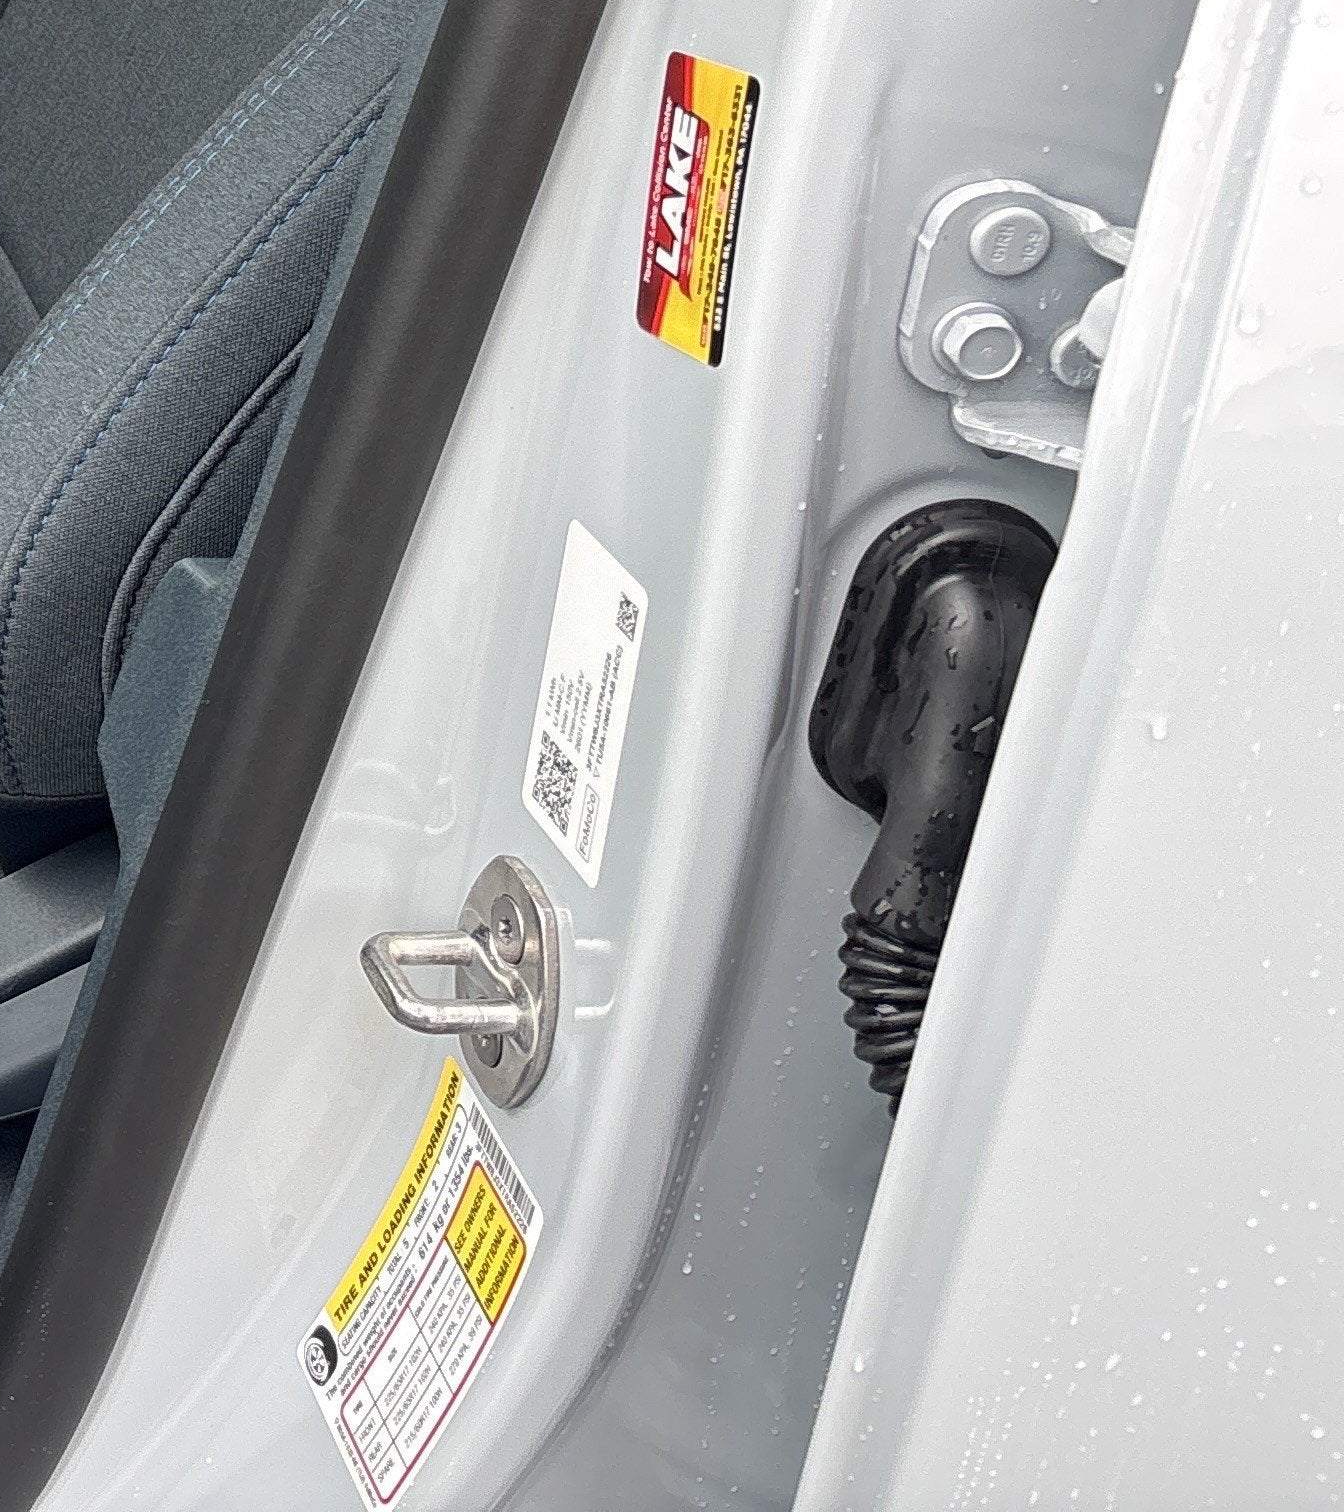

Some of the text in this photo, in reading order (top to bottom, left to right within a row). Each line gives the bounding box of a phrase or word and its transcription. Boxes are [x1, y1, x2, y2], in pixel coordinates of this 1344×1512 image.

[654, 104, 699, 277] LAKE
[579, 794, 596, 855] FoMoCo
[334, 1071, 459, 1321] TIRE AND LOADING INFORMATION
[464, 1202, 496, 1273] MANUAL FOR
[476, 1225, 507, 1289] ADDITIONAL
[484, 1235, 519, 1310] INFORMATION
